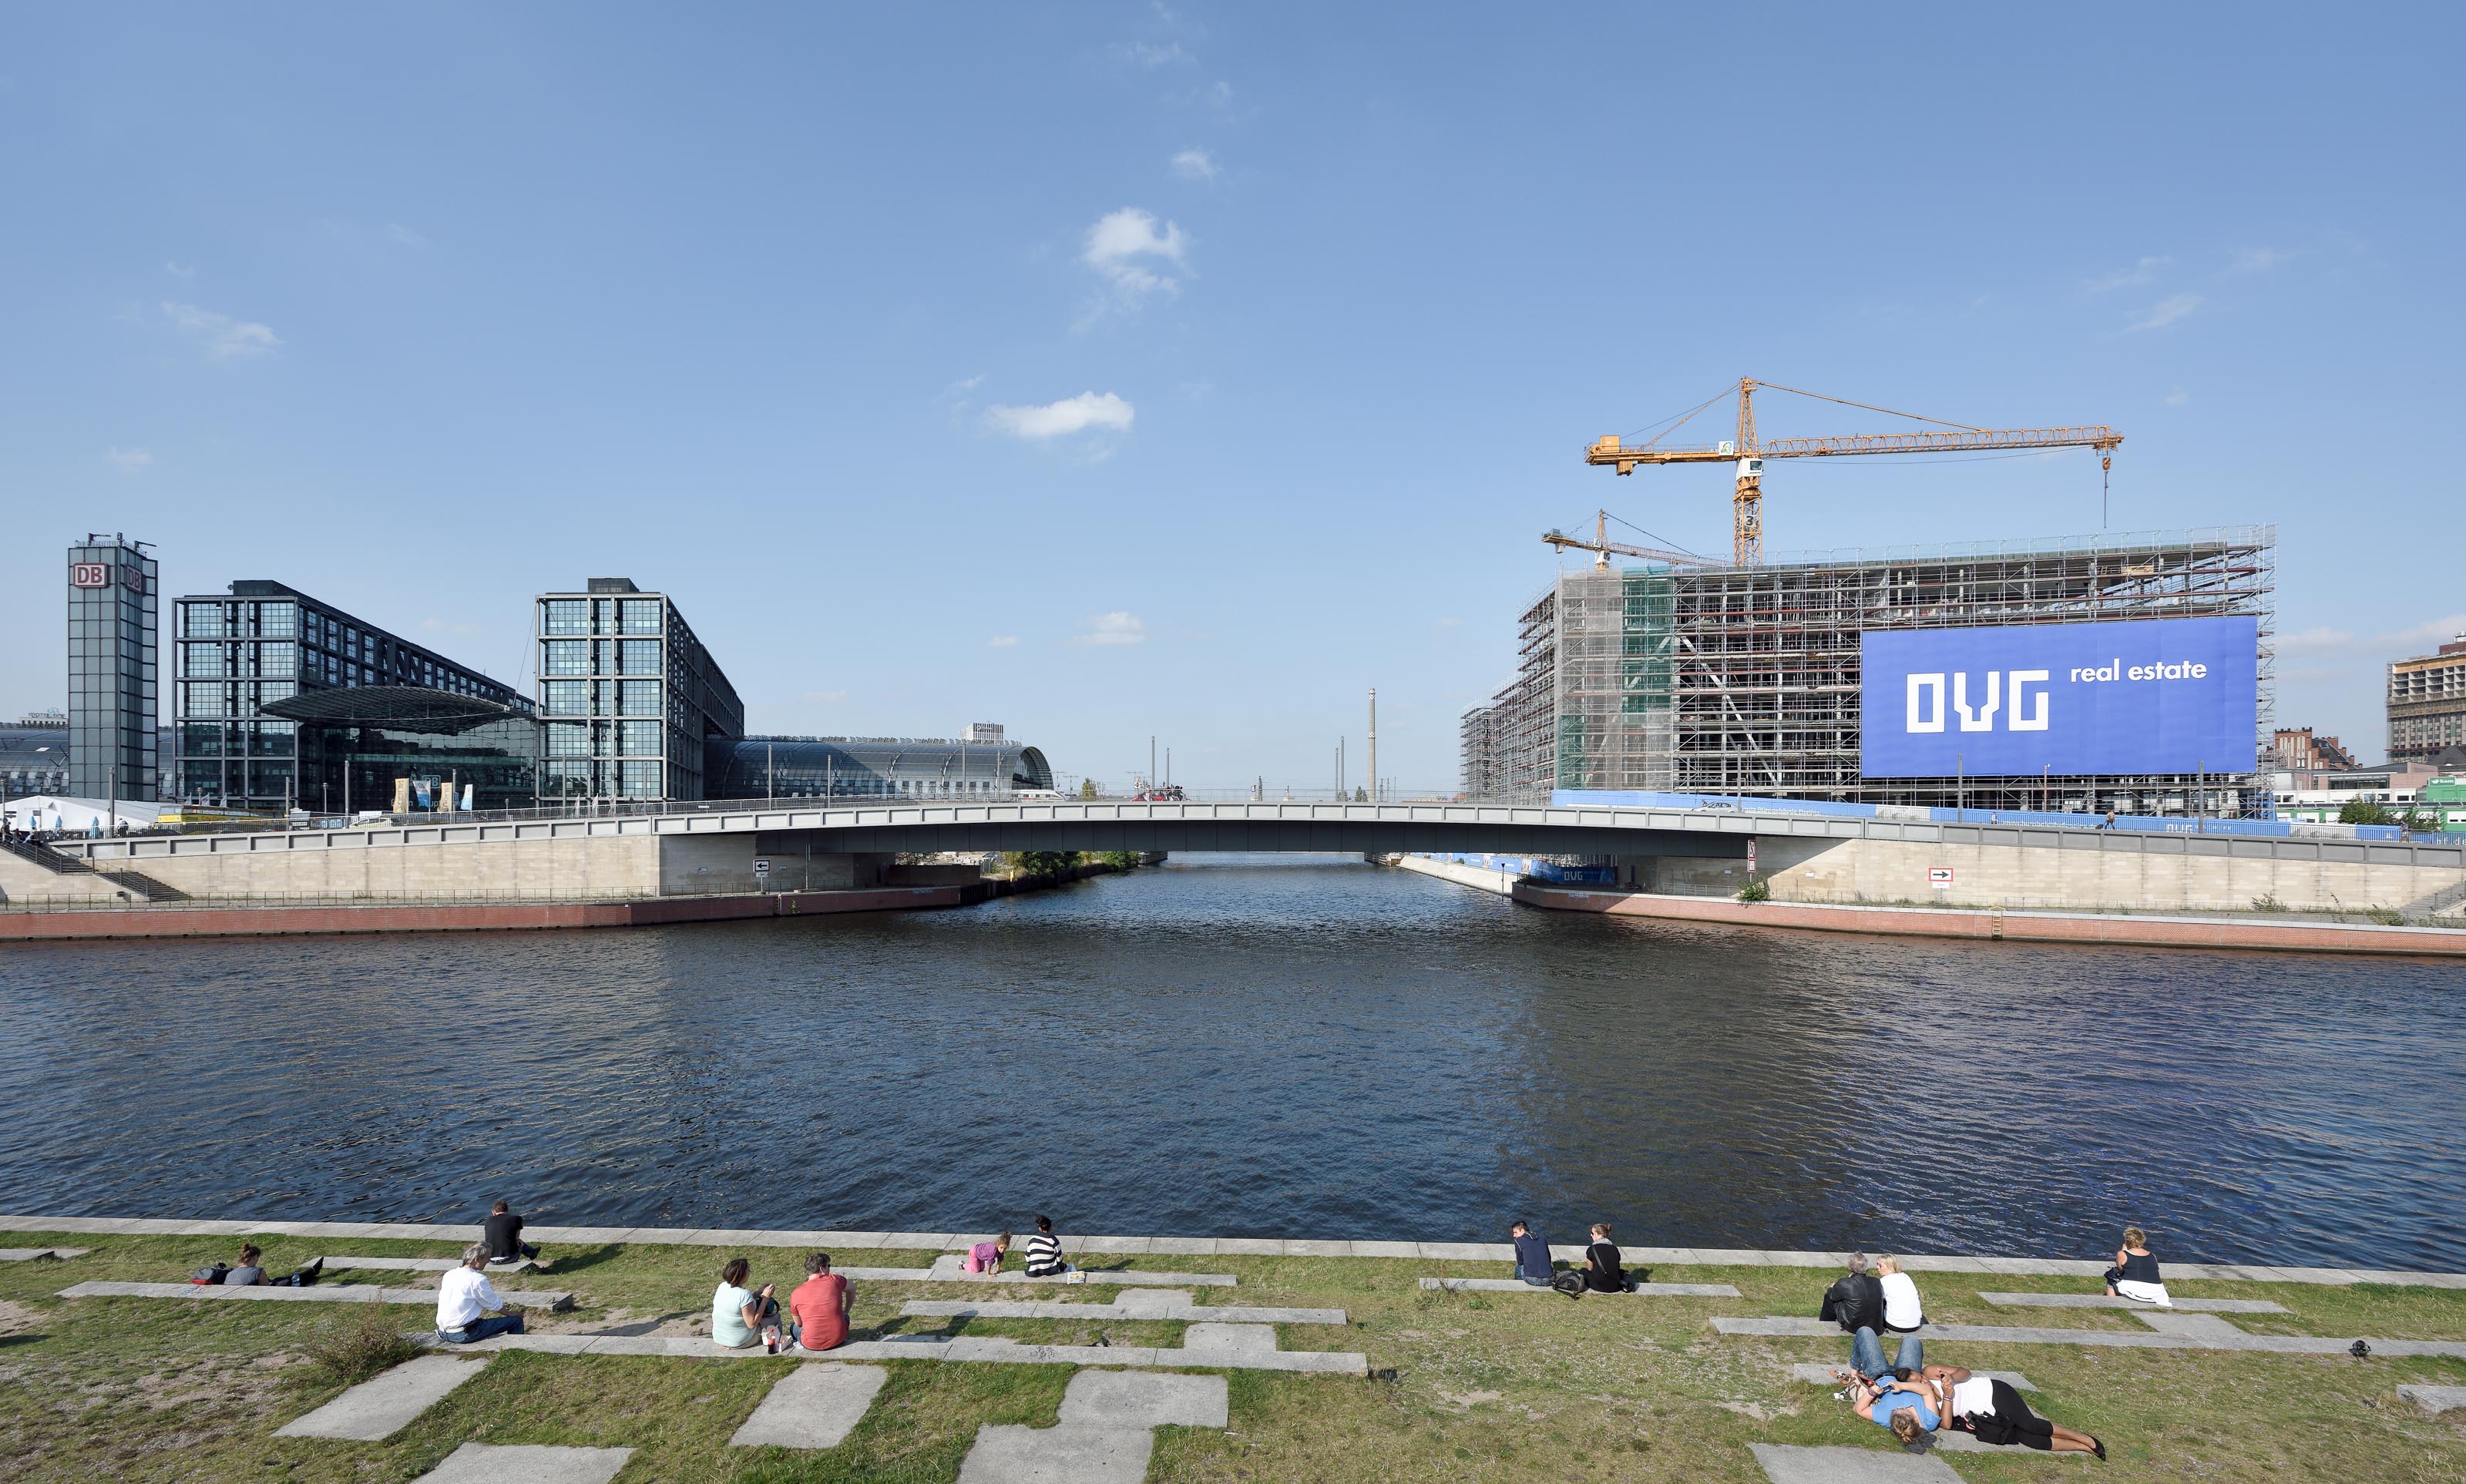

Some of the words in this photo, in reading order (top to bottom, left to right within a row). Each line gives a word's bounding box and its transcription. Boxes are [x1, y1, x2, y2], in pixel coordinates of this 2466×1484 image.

[1746, 515, 1753, 525] 3
[77, 566, 102, 583] DB
[128, 568, 141, 588] DB
[1907, 669, 2050, 734] OVG
[2071, 658, 2120, 683] real
[2128, 660, 2208, 681] estate
[1564, 871, 1583, 881] OVG
